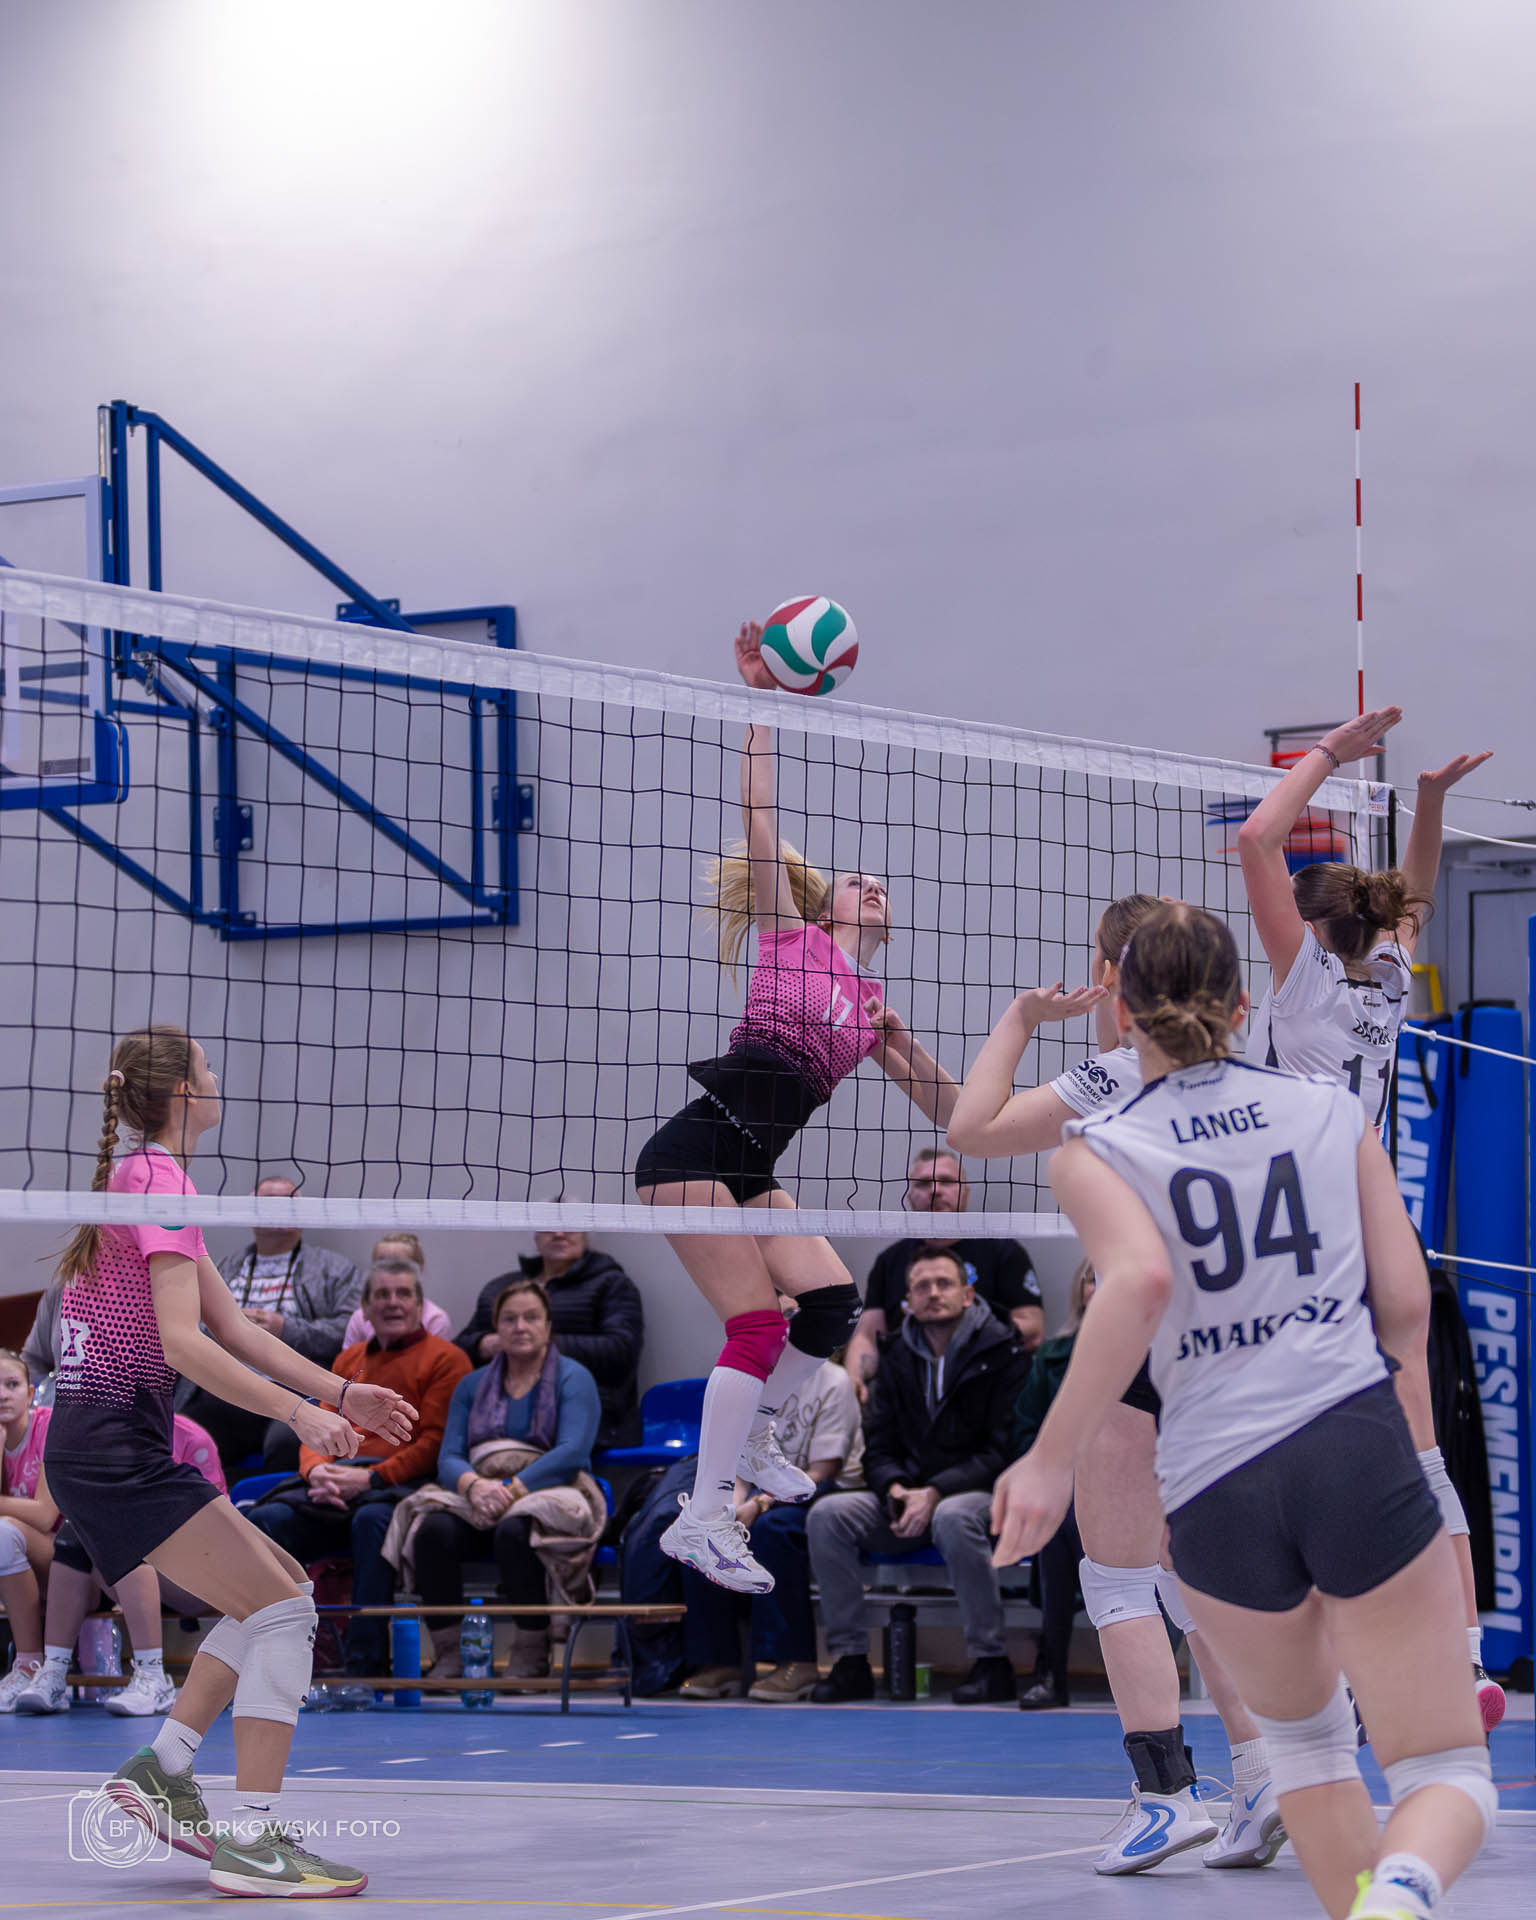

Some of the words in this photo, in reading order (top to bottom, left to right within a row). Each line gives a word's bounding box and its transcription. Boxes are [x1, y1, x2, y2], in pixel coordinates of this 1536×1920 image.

[1078, 1060, 1119, 1095] SOS
[1171, 1102, 1269, 1143] LANGE
[1169, 1151, 1321, 1292] 94
[1177, 1295, 1344, 1361] SMAKSZ
